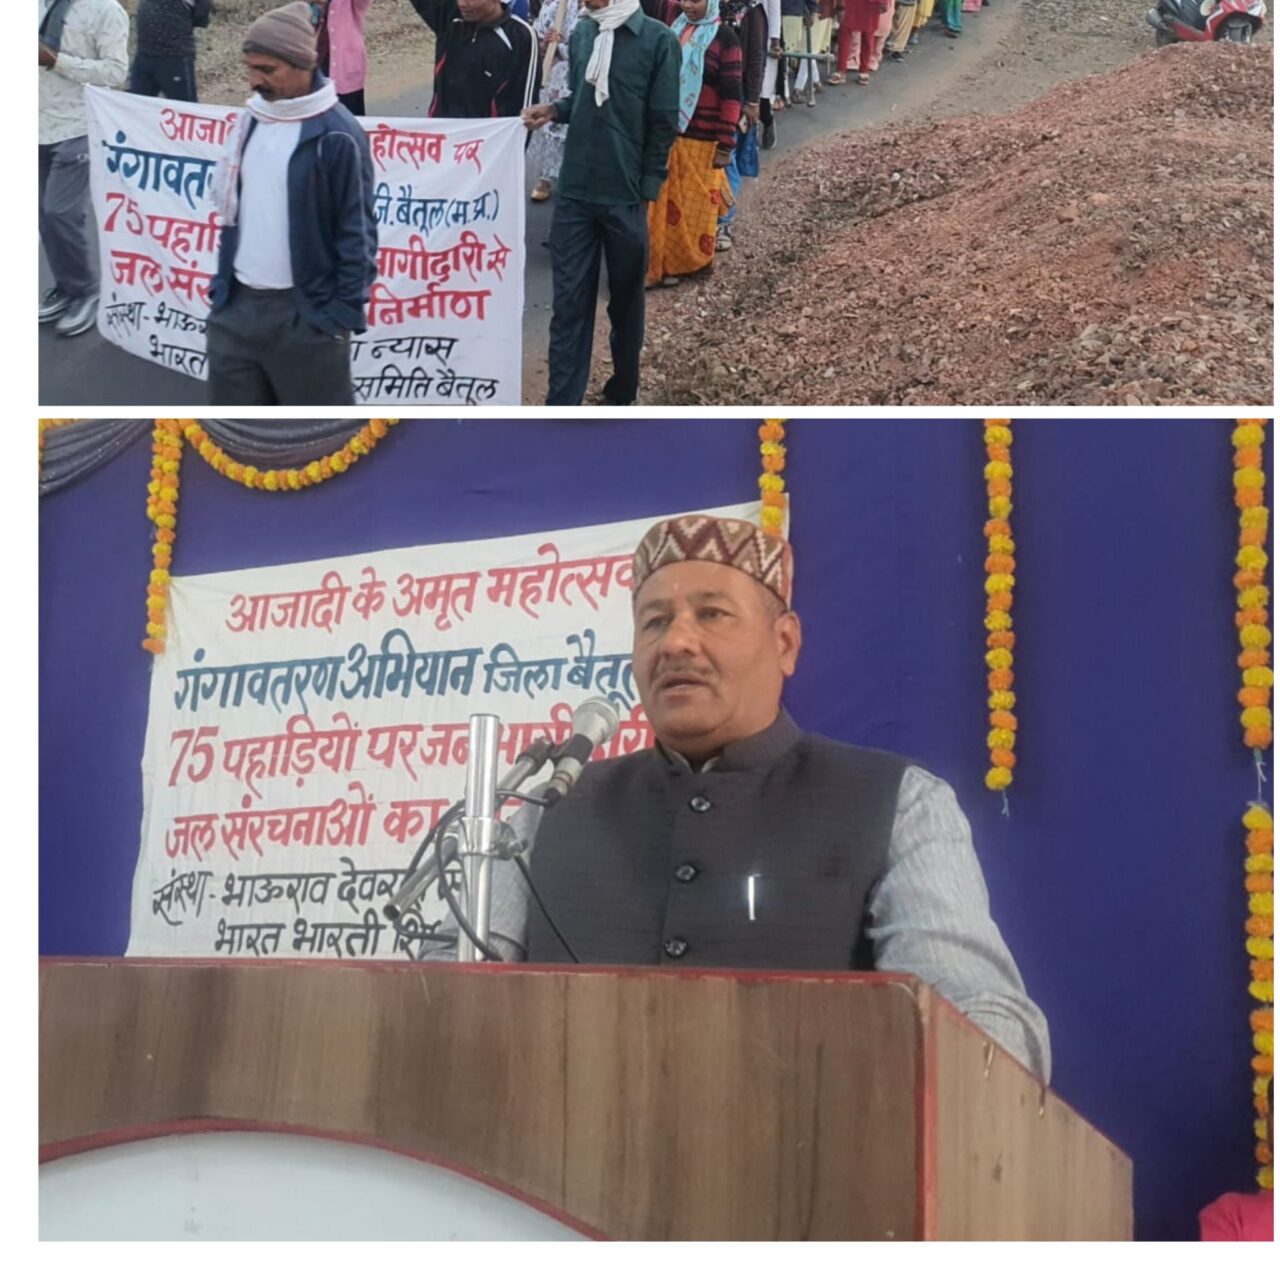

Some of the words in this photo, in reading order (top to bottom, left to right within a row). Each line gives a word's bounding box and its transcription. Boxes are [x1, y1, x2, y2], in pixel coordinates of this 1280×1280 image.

[453, 139, 484, 175] पर
[104, 191, 144, 236] 75
[396, 184, 449, 237] बैतूल
[110, 250, 165, 298] जल
[367, 282, 492, 327] निर्माण
[149, 334, 208, 375] भारत
[353, 364, 435, 402] समिति
[436, 368, 500, 405] बैतूल
[371, 335, 460, 367] न्यास
[225, 570, 351, 634] आजादी
[352, 565, 387, 620] के
[392, 572, 482, 631] अमृत
[174, 647, 345, 716] गंगावतरण
[340, 627, 484, 700] अभियान
[483, 642, 568, 700] जिला
[168, 725, 220, 787] 75
[222, 710, 363, 799] पहाड़ियों
[366, 723, 424, 782] पर
[165, 813, 220, 862] जल
[221, 780, 377, 861] संरचनाओं
[383, 798, 450, 844] का
[222, 872, 337, 914] भाऊराव
[214, 917, 286, 957] भारत
[292, 907, 387, 958] भारती
